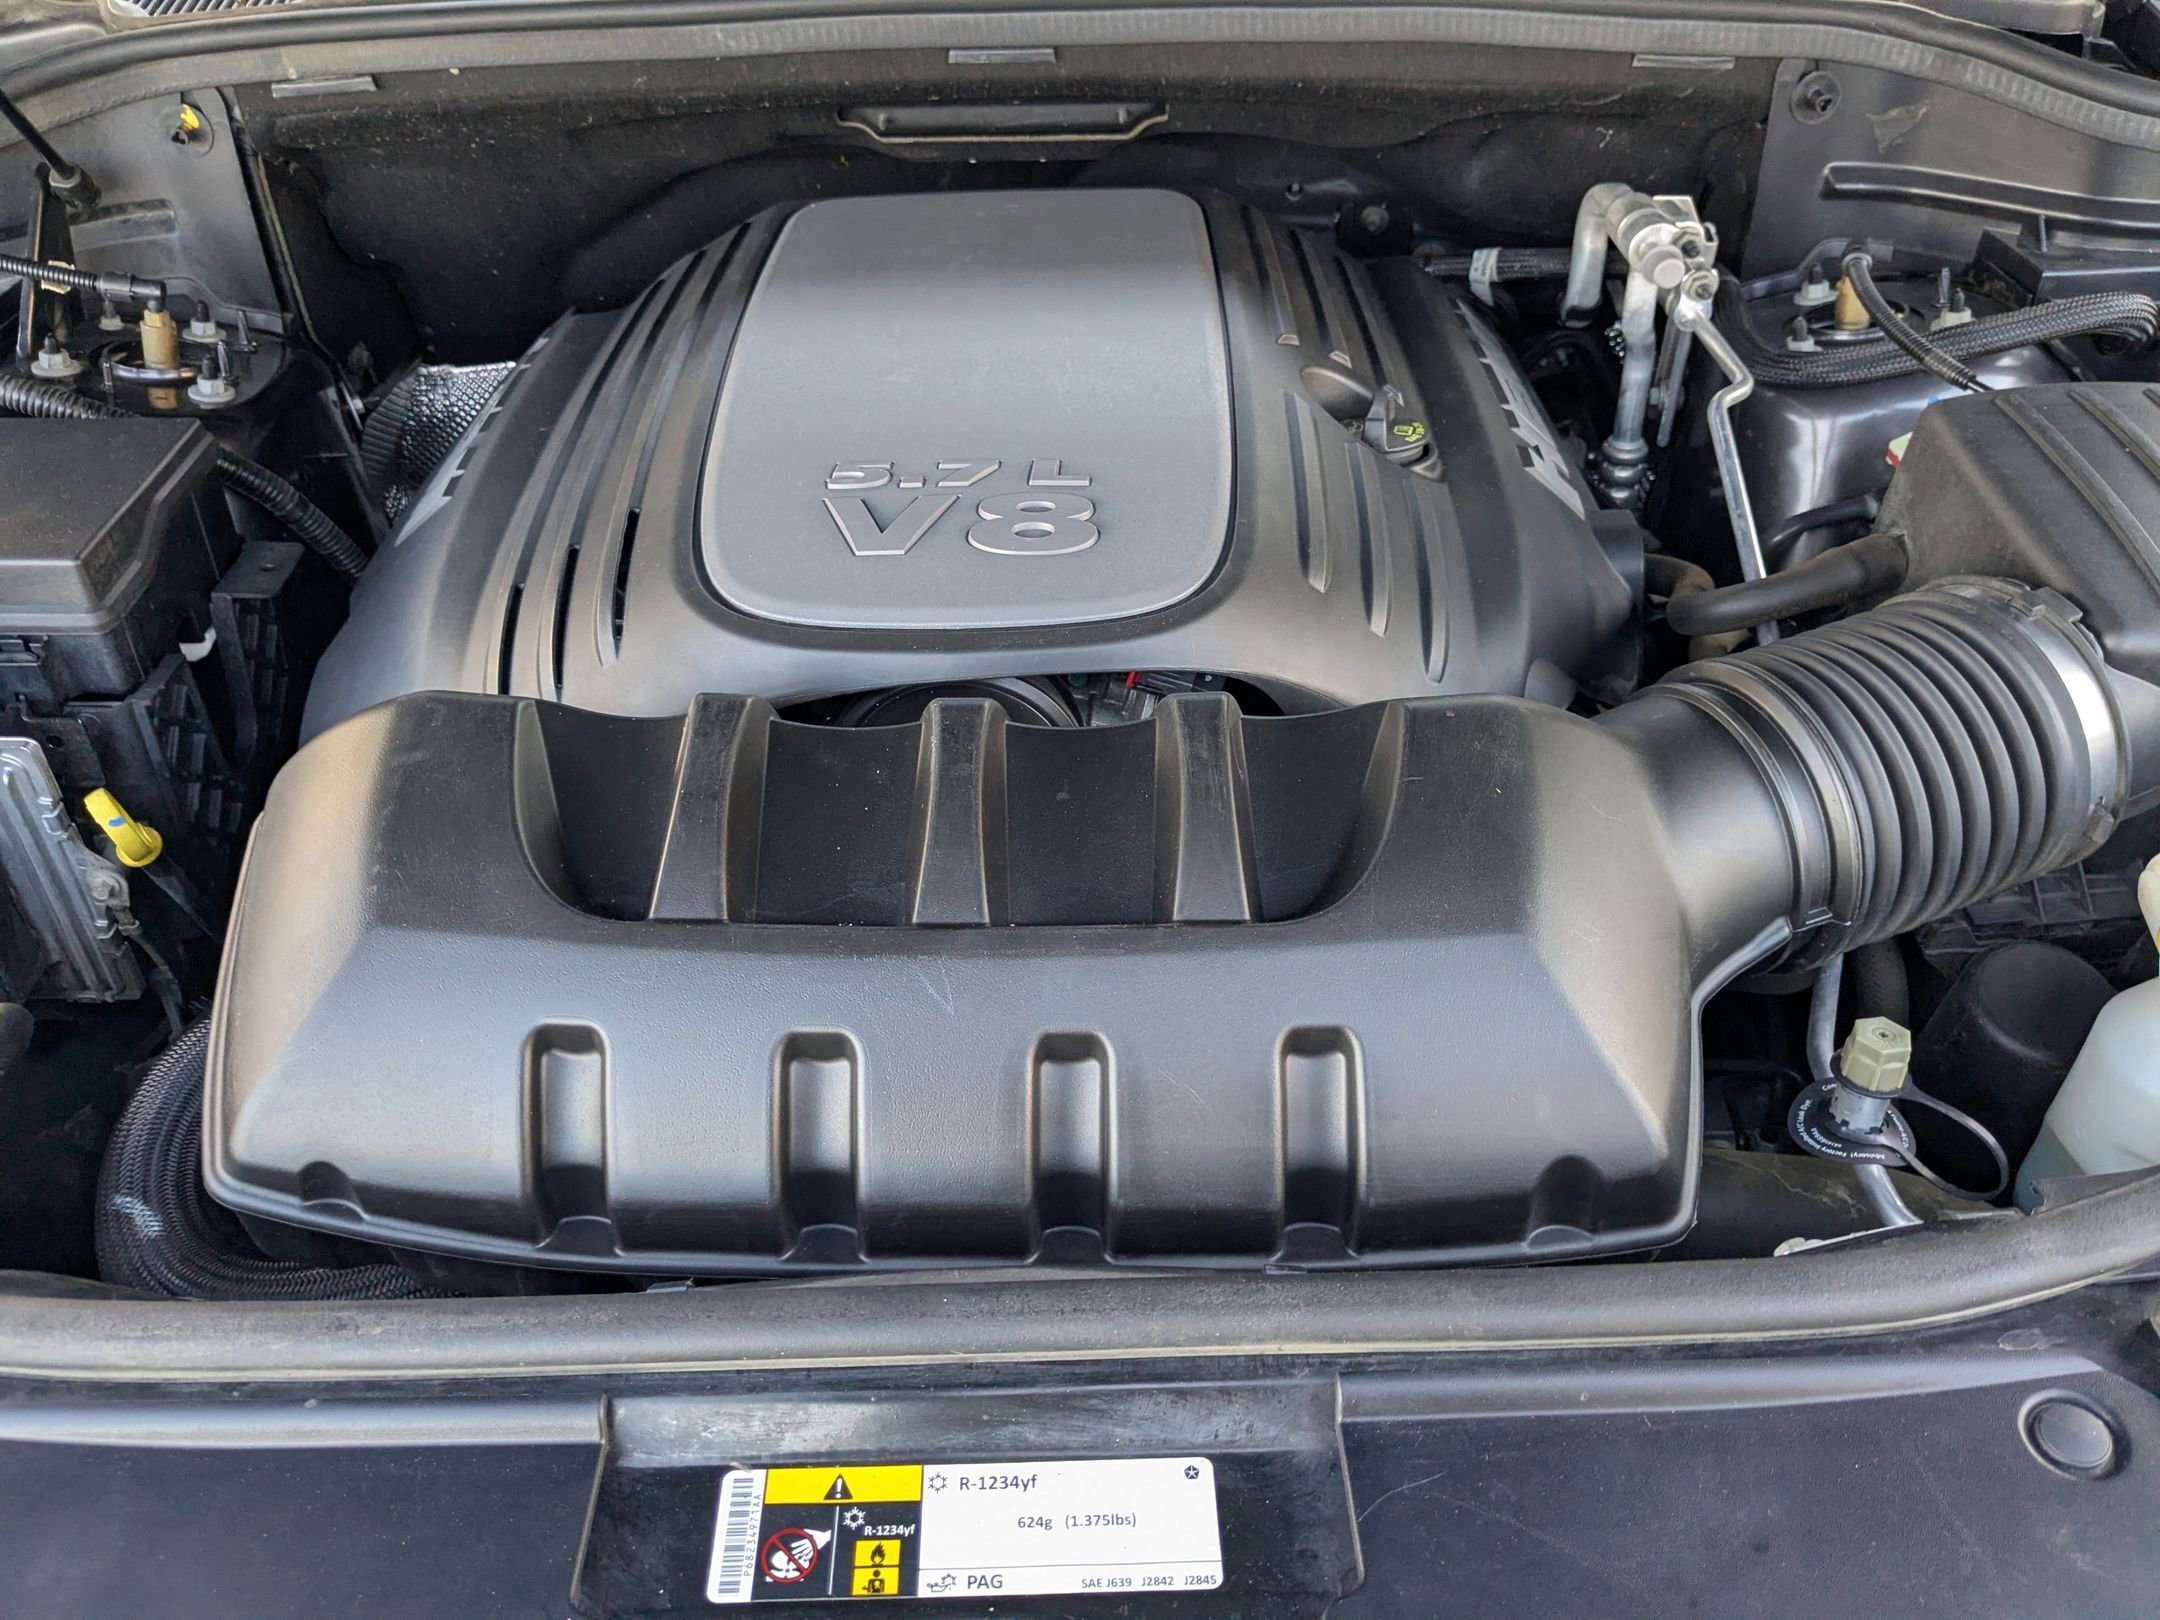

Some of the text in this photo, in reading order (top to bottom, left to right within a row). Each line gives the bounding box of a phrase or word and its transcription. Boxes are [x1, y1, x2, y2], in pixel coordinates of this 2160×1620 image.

[826, 459, 1091, 490] 5.7 L
[822, 491, 1099, 557] V8
[1820, 1147, 1847, 1158] Factory
[959, 1474, 1038, 1493] R-1234yf
[864, 1523, 916, 1537] R-1234yf
[1017, 1512, 1137, 1530] 624g (1.375lbs)
[743, 1494, 762, 1577] P68234971AA
[967, 1574, 1003, 1590] PAG
[1081, 1575, 1217, 1588] SAE J639 J2842 J2845
